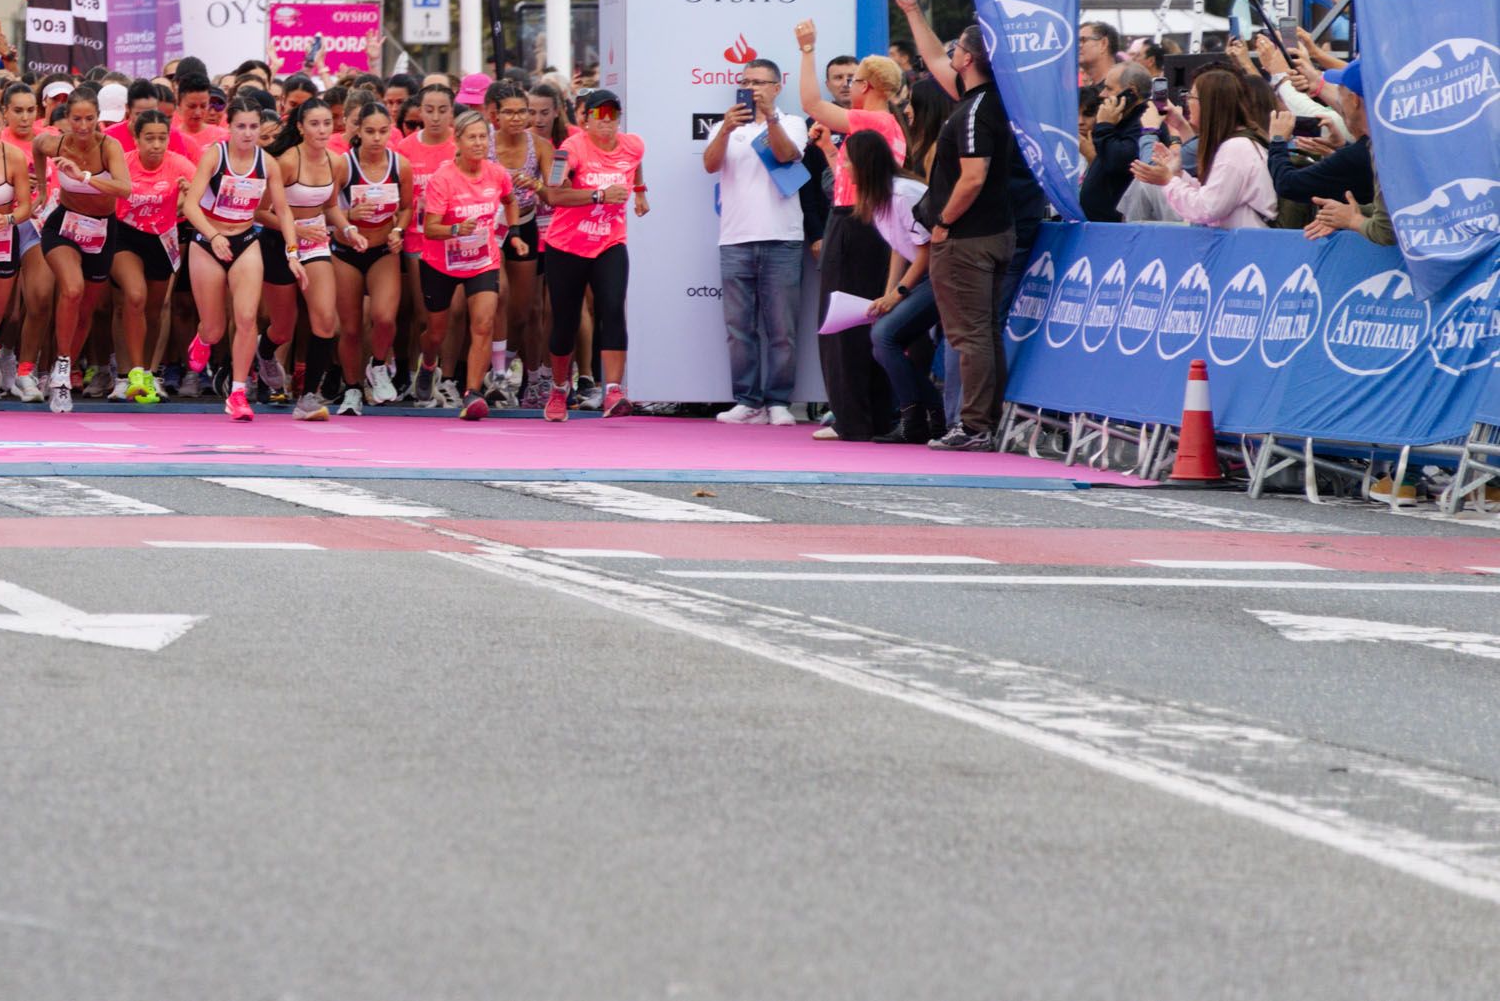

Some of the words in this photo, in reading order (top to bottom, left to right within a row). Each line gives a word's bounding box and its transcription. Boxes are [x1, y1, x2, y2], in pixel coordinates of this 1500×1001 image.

[333, 11, 377, 23] OYSHO
[691, 67, 789, 85] Santar
[687, 286, 723, 301] octop
[1329, 304, 1420, 350] ASTURIANA
